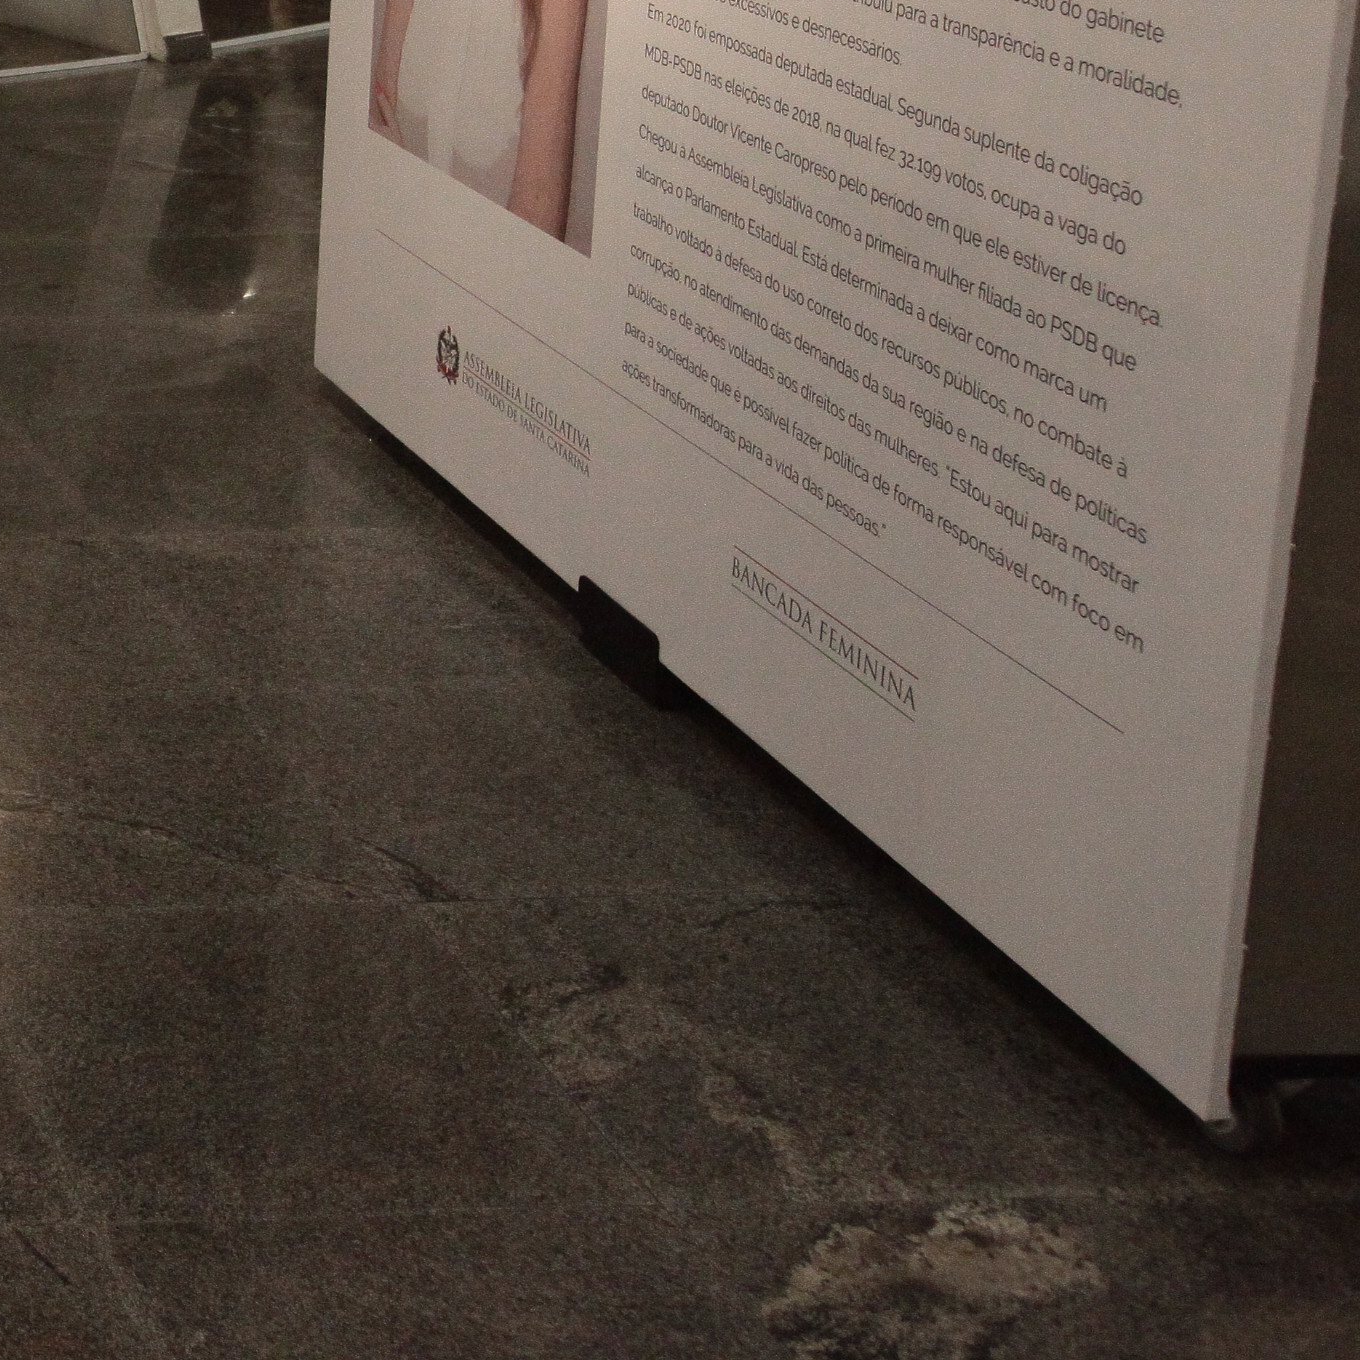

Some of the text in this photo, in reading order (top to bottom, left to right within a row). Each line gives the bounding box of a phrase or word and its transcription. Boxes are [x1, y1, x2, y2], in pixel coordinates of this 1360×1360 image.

[790, 14, 800, 30] e
[638, 123, 677, 155] Chegou
[687, 146, 750, 189] Assembleia
[751, 175, 813, 219] Legislativa
[814, 209, 852, 237] como
[853, 227, 862, 243] a
[864, 232, 920, 271] primeira
[922, 259, 975, 295] mulher
[977, 280, 1022, 319] filiada
[1025, 307, 1047, 330] ao
[1050, 313, 1098, 354] PSDB
[1100, 343, 1137, 372] que
[464, 351, 591, 455] ASSEMBLEIA LEGISLATIVA
[621, 359, 650, 388] ações
[652, 376, 736, 444] transformadoras
[737, 434, 763, 462] para
[764, 452, 773, 468] a
[774, 458, 799, 485] vida
[801, 475, 824, 501] das
[732, 556, 916, 711] BANCADA FEMININA
